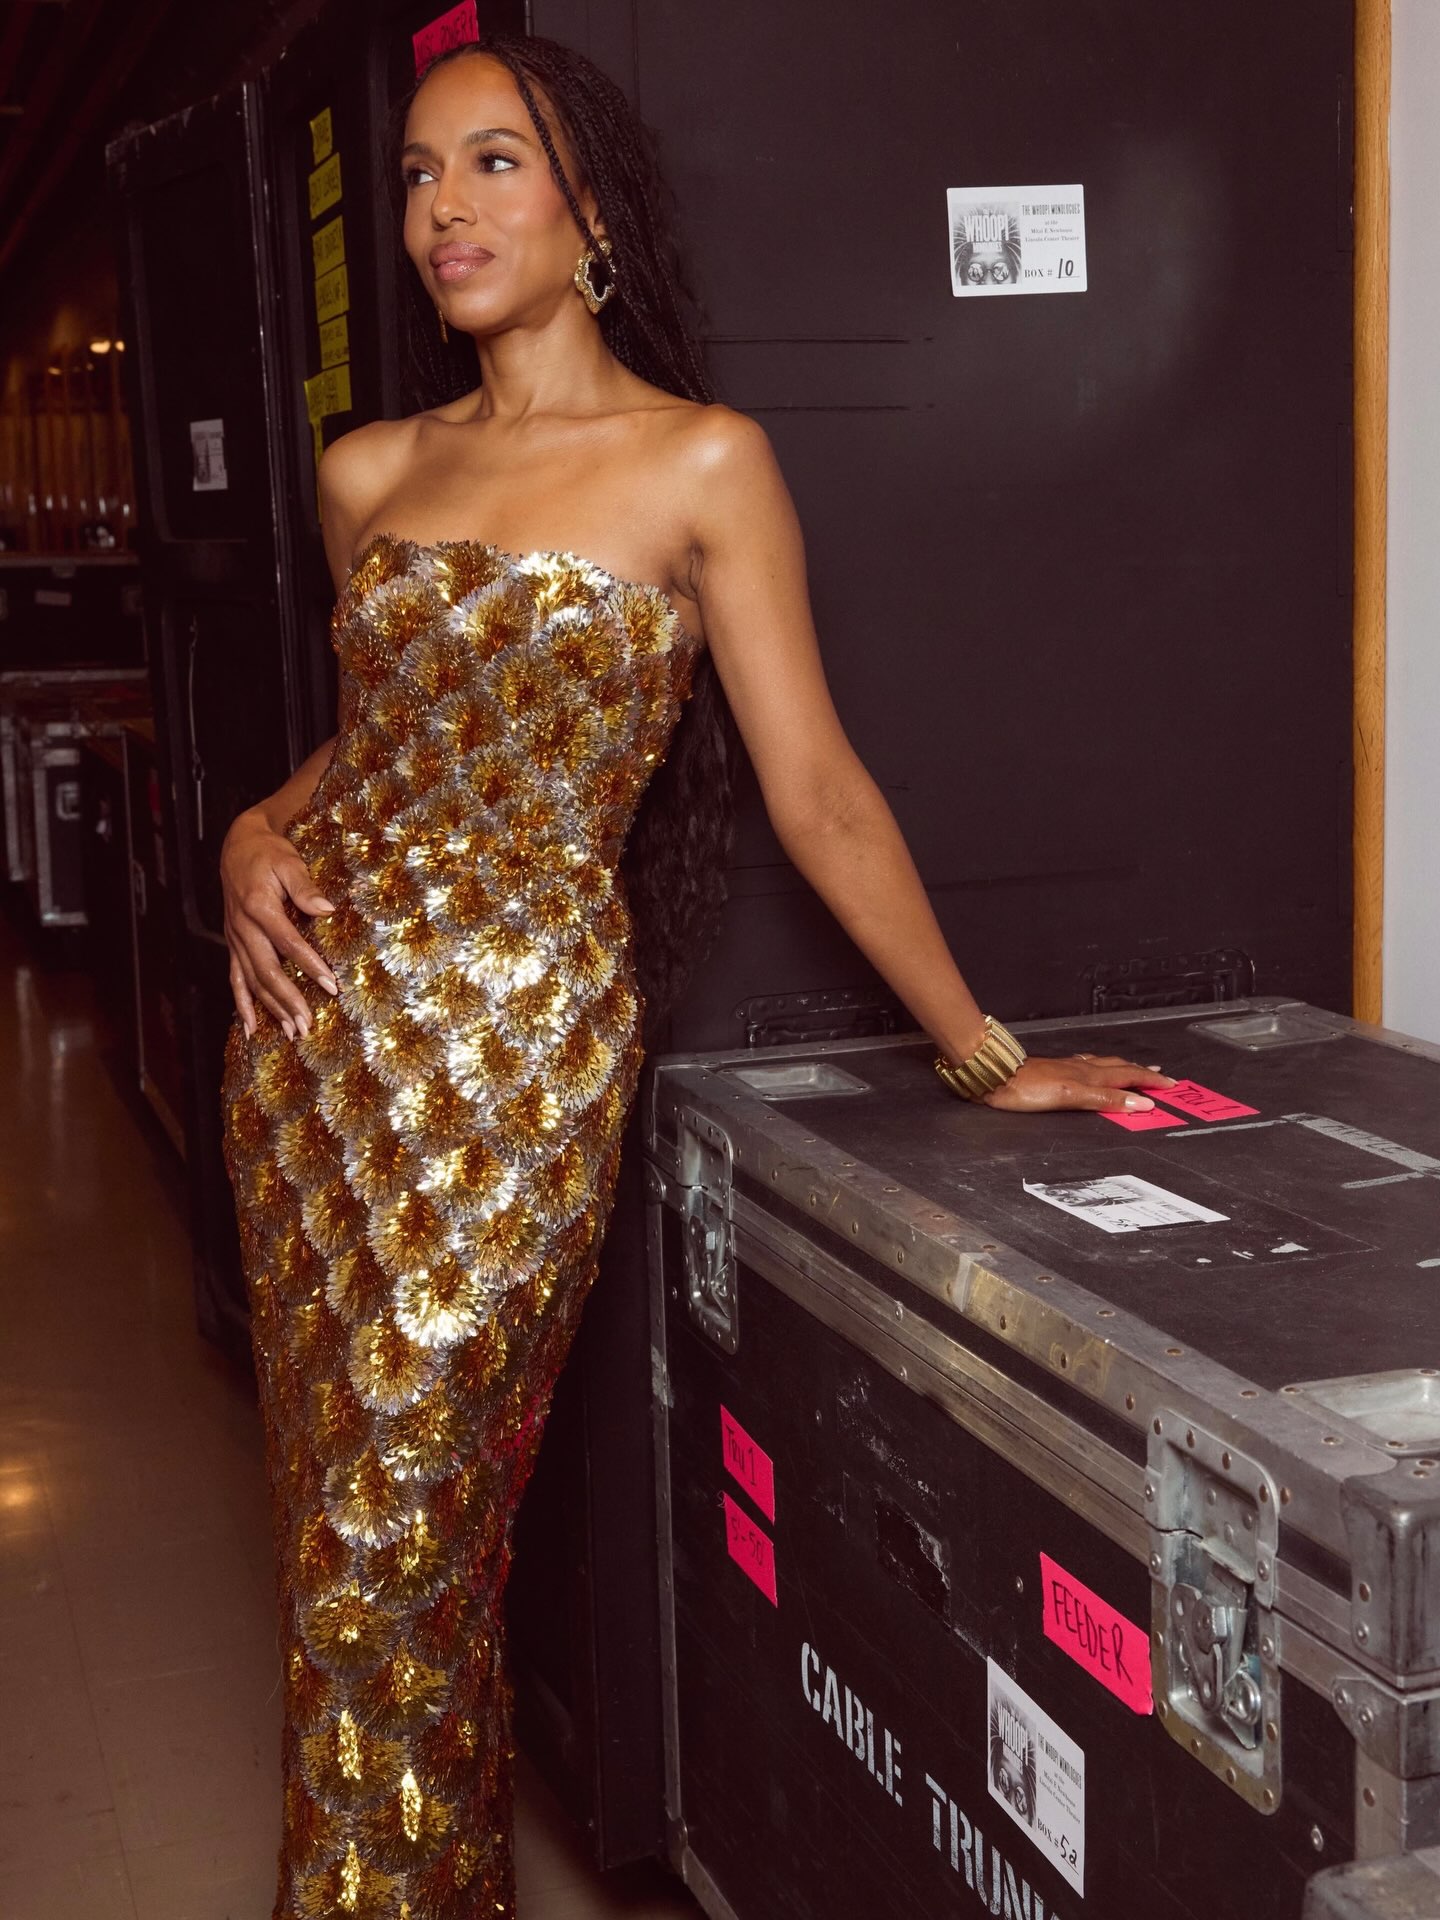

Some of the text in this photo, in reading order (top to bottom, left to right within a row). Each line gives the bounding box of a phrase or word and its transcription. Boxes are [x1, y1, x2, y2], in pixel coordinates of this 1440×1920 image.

[1032, 204, 1050, 216] WHOOPI
[964, 213, 1009, 242] WHOOPI
[1024, 268, 1044, 278] BOX
[1058, 258, 1074, 279] 10
[1051, 1579, 1134, 1687] FEEDER
[800, 1641, 904, 1808] CABLE
[997, 1701, 1029, 1766] WHOOPI
[1045, 1740, 1059, 1765] WHOOPI
[1037, 1817, 1052, 1843] BOX
